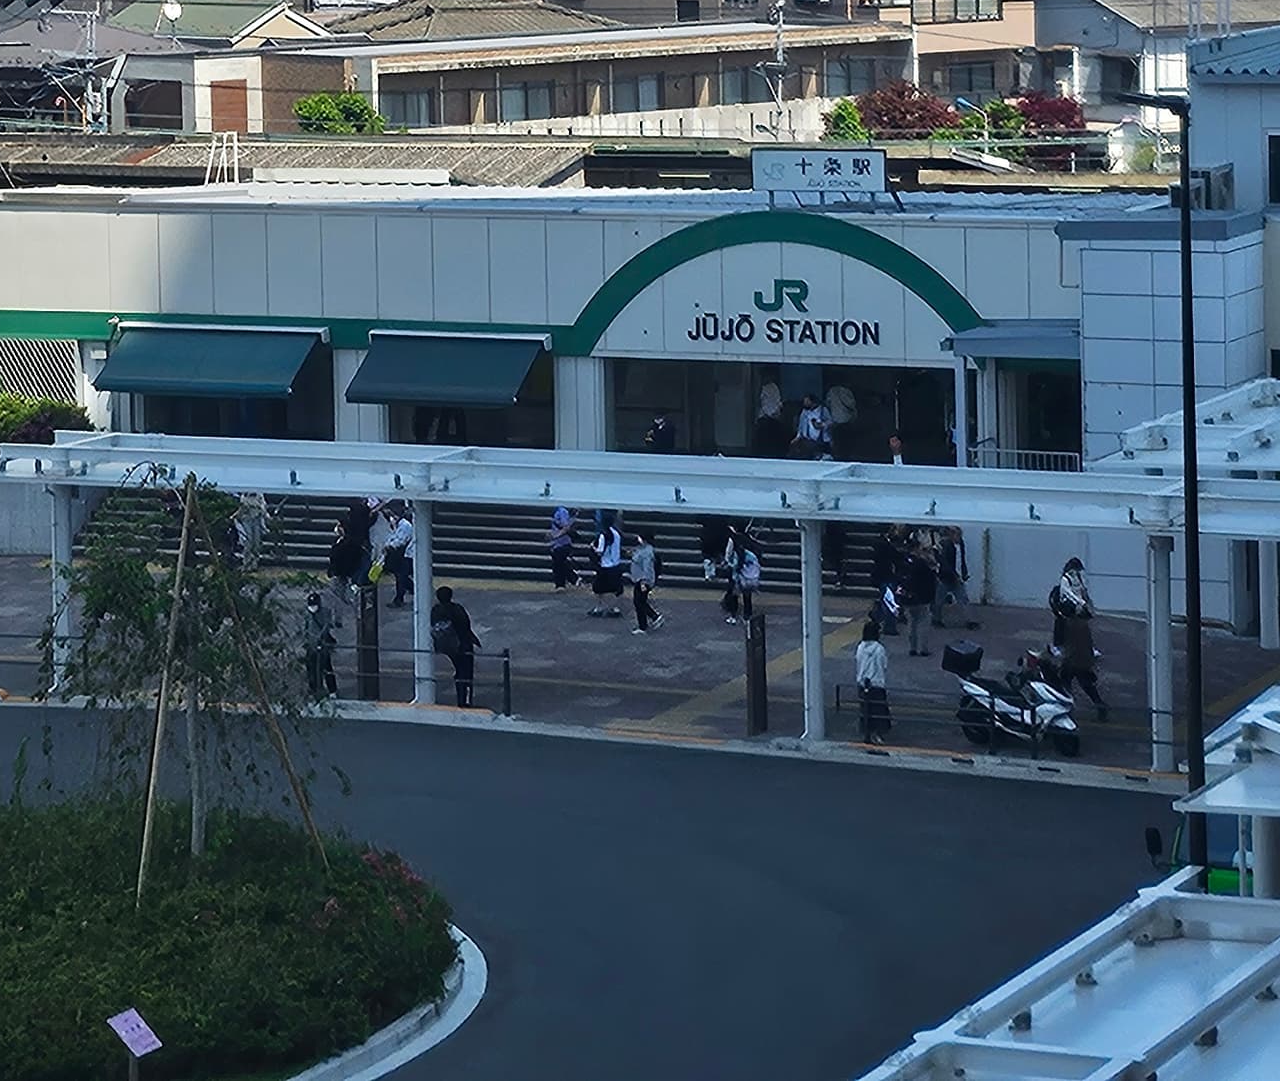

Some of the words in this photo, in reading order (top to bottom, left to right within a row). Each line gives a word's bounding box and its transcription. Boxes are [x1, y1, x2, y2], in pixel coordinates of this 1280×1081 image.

[795, 157, 871, 176] 十条駅
[754, 279, 808, 312] JR
[765, 319, 880, 346] STATION
